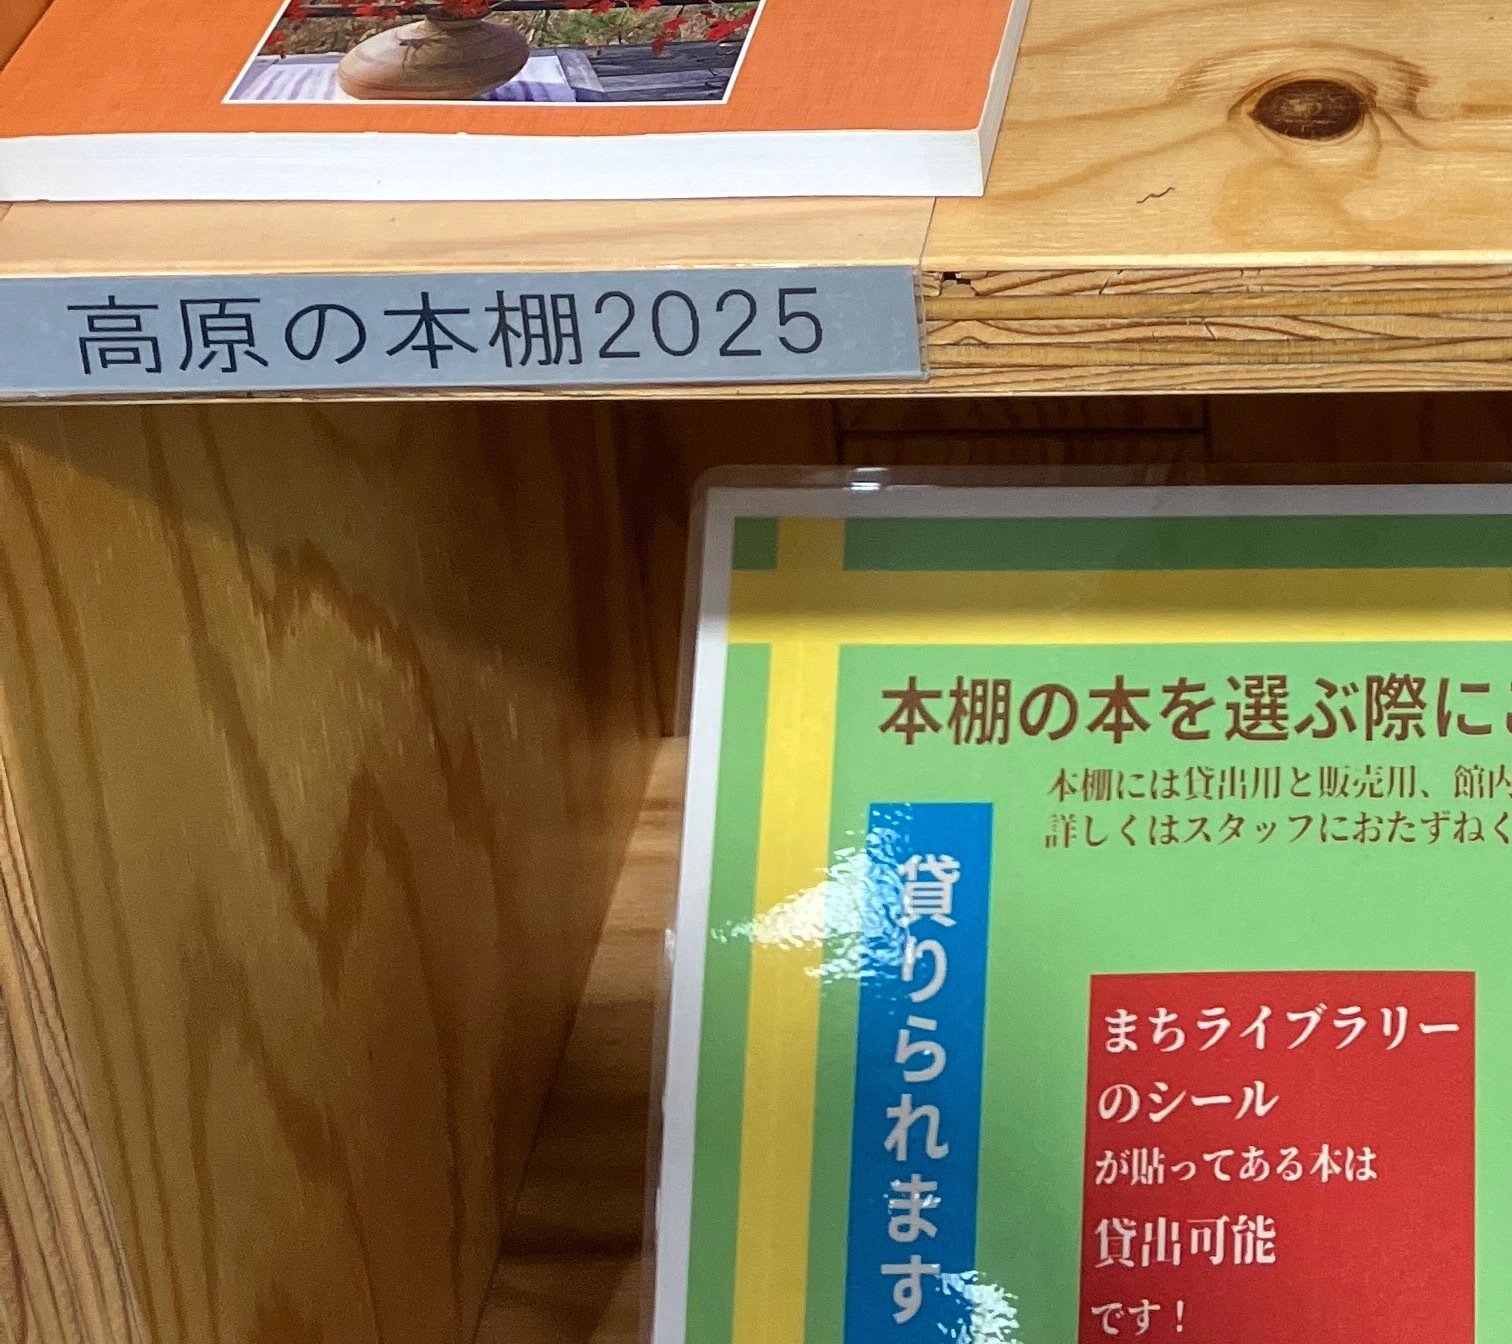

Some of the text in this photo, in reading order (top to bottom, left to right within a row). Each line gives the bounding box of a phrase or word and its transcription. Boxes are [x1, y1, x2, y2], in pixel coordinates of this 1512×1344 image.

[67, 286, 825, 375] 高原の本棚2025
[1103, 1002, 1460, 1054] まちライブラリー
[879, 853, 962, 1325] 貸りられます
[1098, 1080, 1279, 1124] のシール
[1094, 1142, 1378, 1186] が貼ってある本は
[1094, 1215, 1276, 1268] 貸出可能
